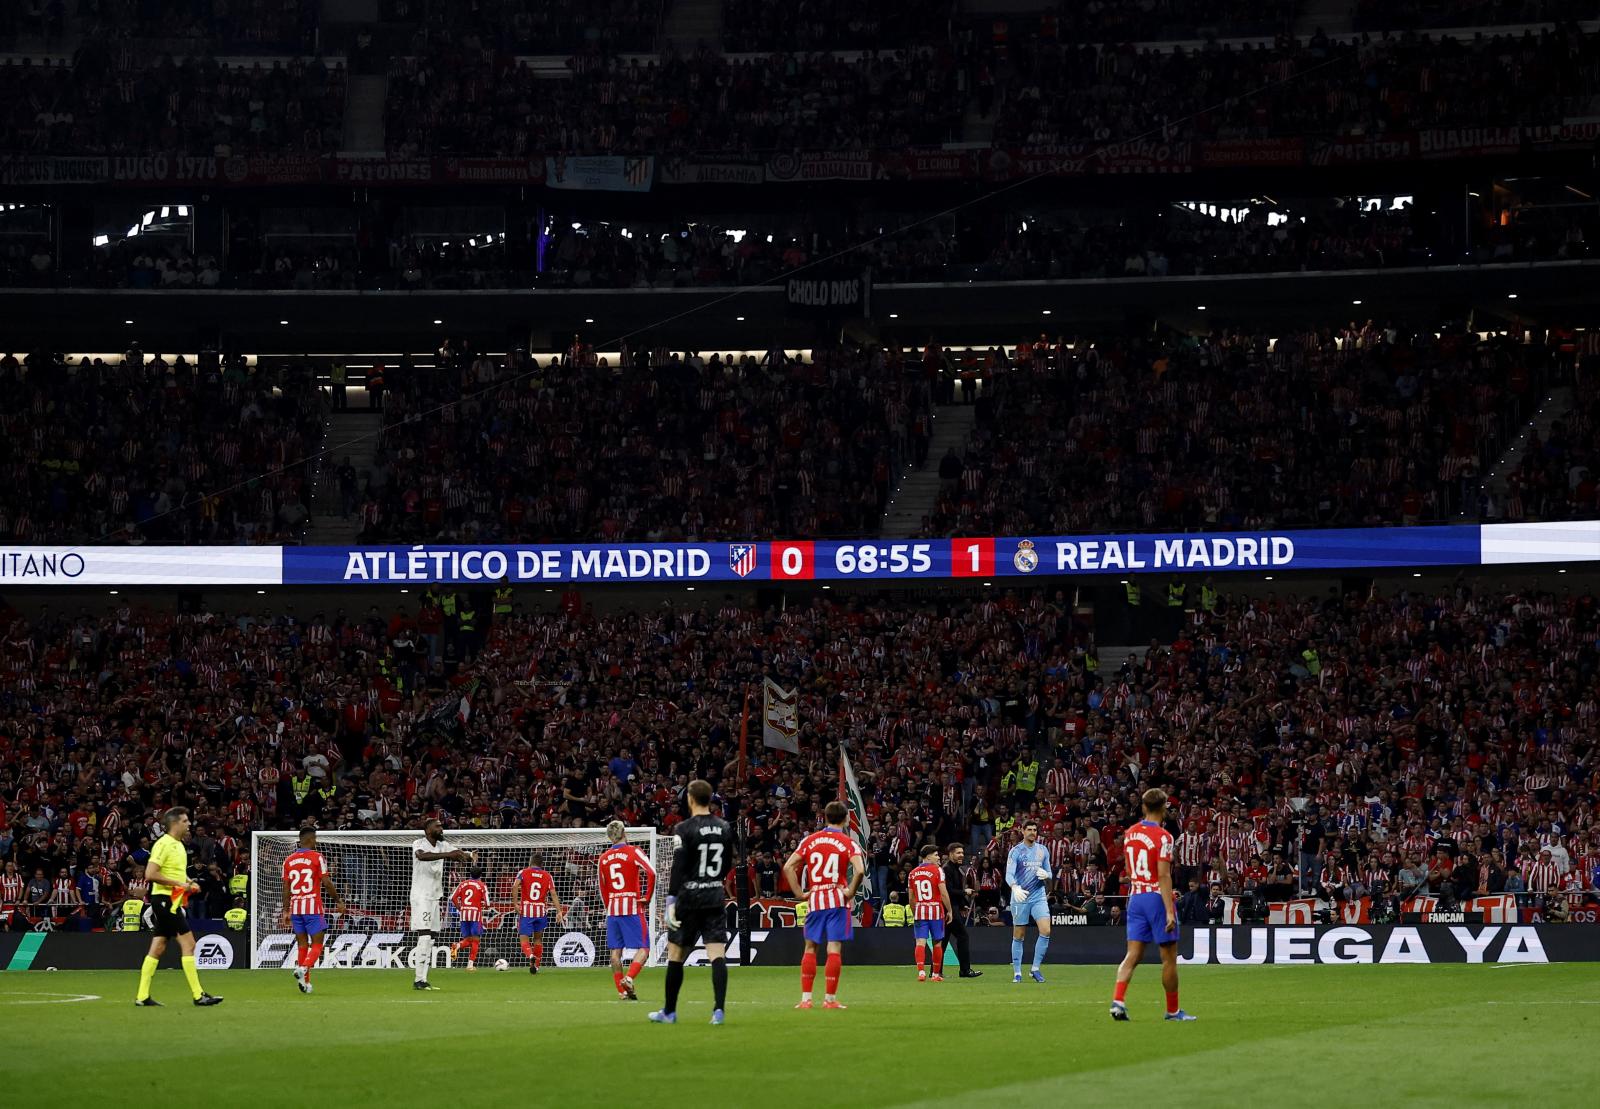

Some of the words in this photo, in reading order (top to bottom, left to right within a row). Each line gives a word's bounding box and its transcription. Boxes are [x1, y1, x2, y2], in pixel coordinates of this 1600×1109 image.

[113, 157, 169, 181] LUGO
[175, 156, 217, 180] 1978
[789, 279, 828, 306] CHOLO
[830, 280, 859, 305] DIOS
[344, 545, 508, 580] ATLÉTICO
[517, 548, 562, 579] DE
[570, 547, 711, 578] MADRID
[781, 547, 803, 576] 0
[834, 544, 932, 574] 68:55
[966, 544, 981, 572] 1
[1055, 540, 1146, 570] REAL
[1153, 536, 1295, 568] MADRID
[698, 843, 725, 878] 13
[810, 851, 840, 884] 24
[1126, 846, 1152, 881] 14
[289, 868, 313, 895] 23
[609, 863, 626, 890] 5
[464, 888, 474, 905] 2
[529, 881, 542, 901] 6
[914, 879, 934, 902] 19
[1051, 914, 1088, 925] FANCAM
[200, 943, 226, 958] EA
[561, 940, 588, 955] EA
[1176, 926, 1431, 965] JUEGA
[1448, 926, 1550, 964] YA
[198, 957, 227, 965] SPORTS
